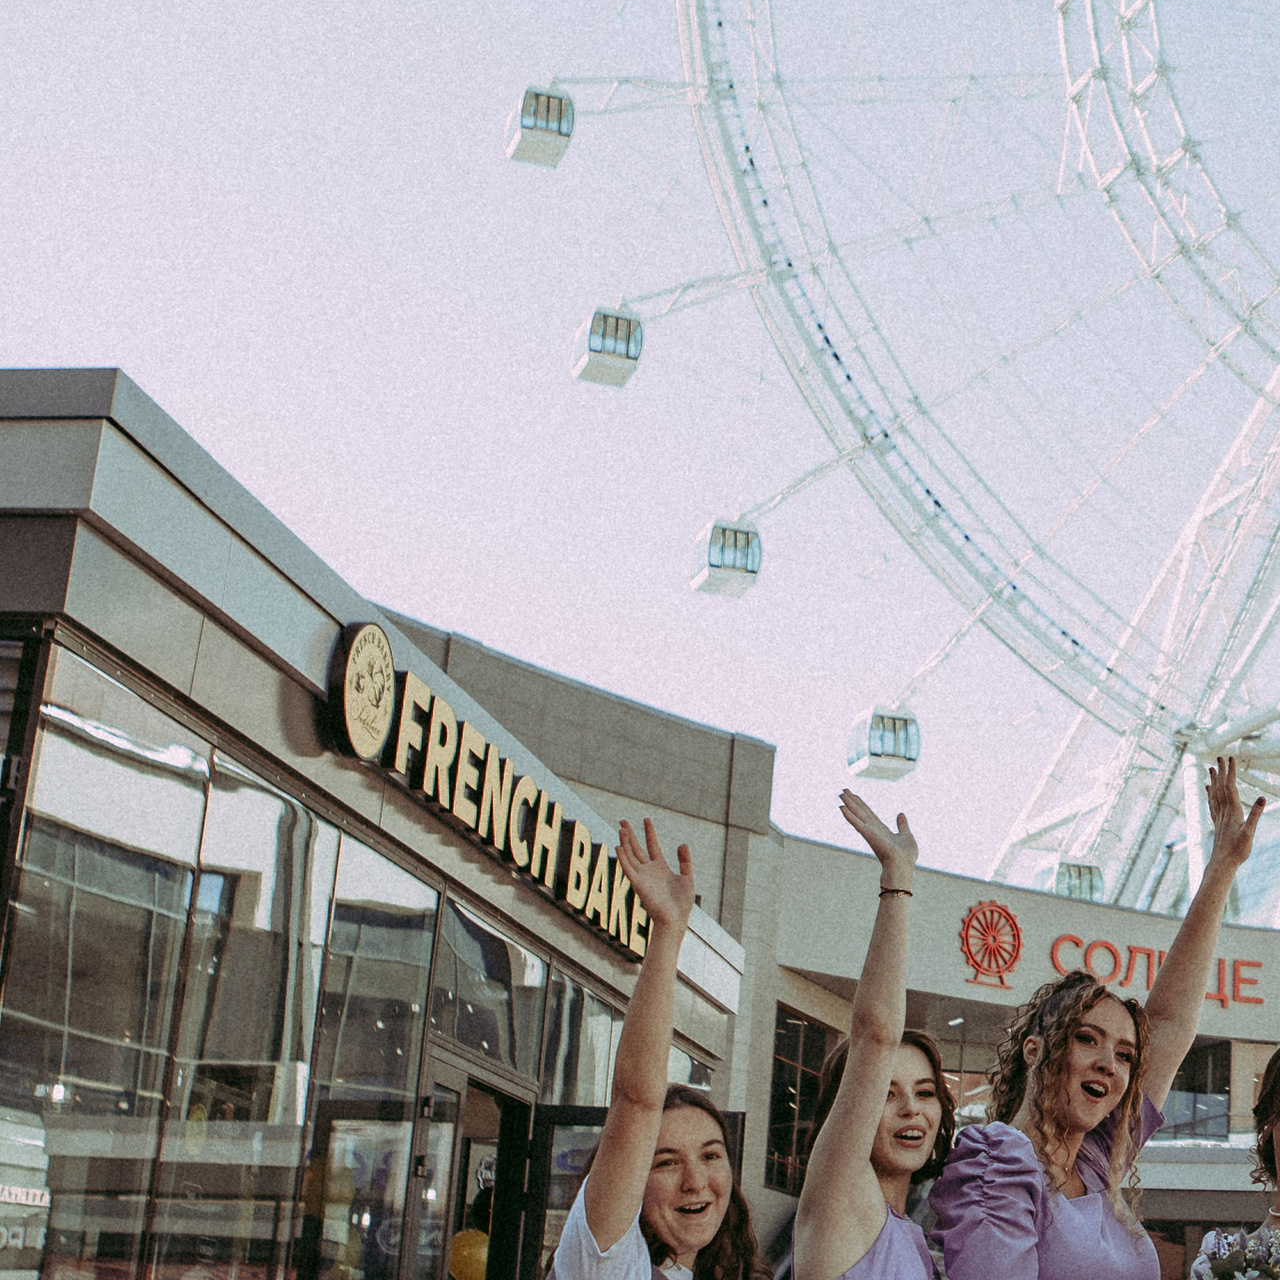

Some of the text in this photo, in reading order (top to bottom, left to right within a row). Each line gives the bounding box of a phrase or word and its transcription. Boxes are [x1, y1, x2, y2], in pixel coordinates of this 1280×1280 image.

[352, 631, 392, 693] FRENCH BAKERY
[394, 670, 654, 958] FRENCH BAKE
[1050, 933, 1264, 1009] СОЛЦЕ
